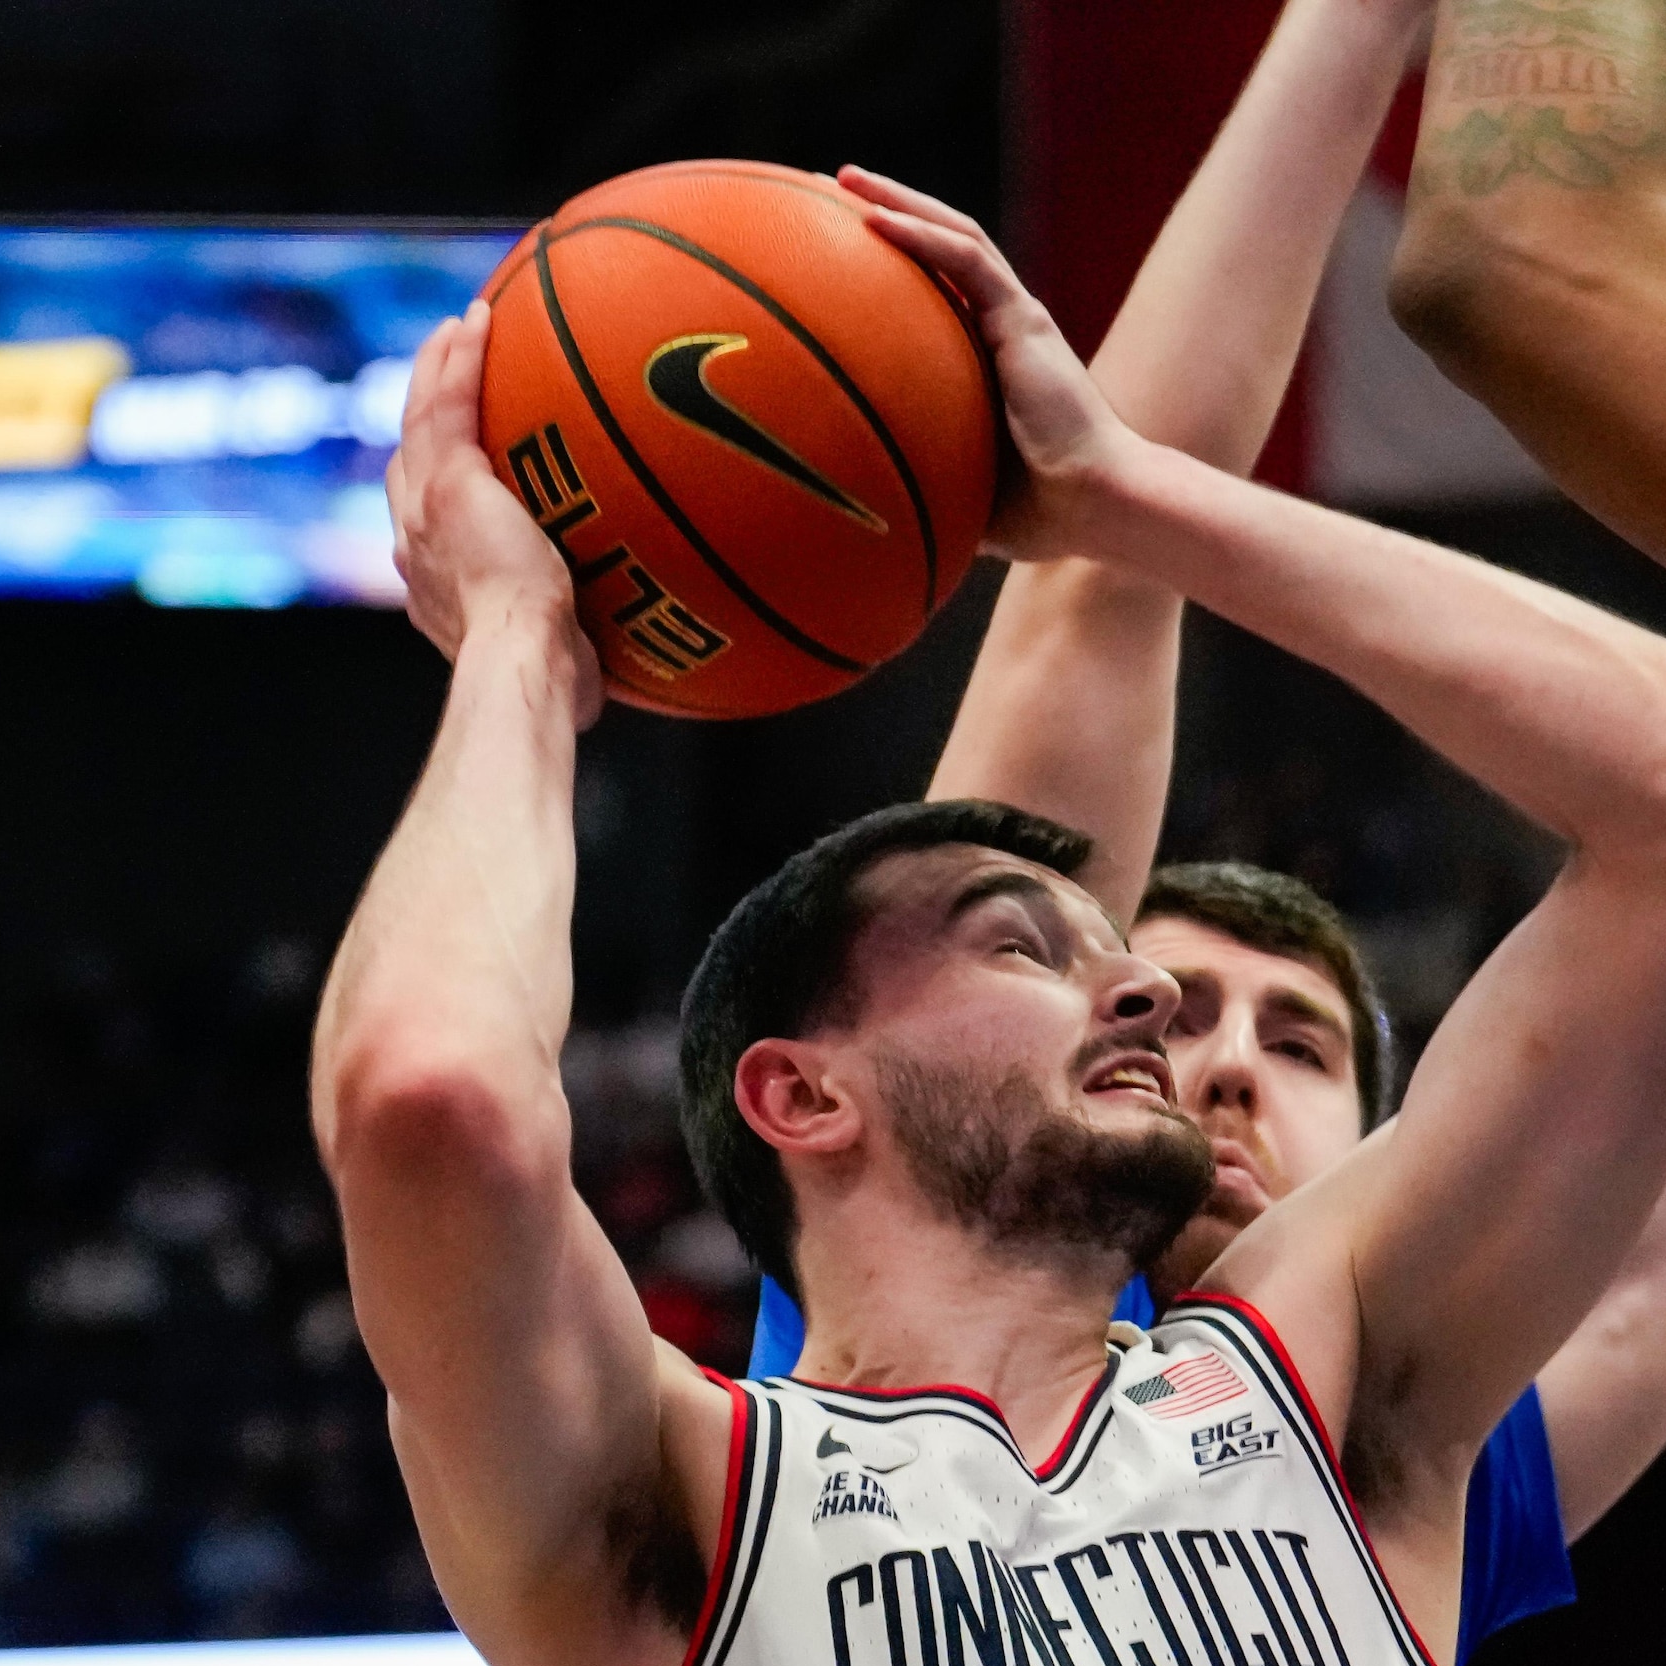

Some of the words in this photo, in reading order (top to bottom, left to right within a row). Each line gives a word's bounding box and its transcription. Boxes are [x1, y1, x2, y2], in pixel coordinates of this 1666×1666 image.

[506, 420, 733, 672] ELITE
[1190, 1410, 1252, 1447] BIG
[1194, 1428, 1280, 1466] EAST
[811, 1493, 900, 1524] CHANG
